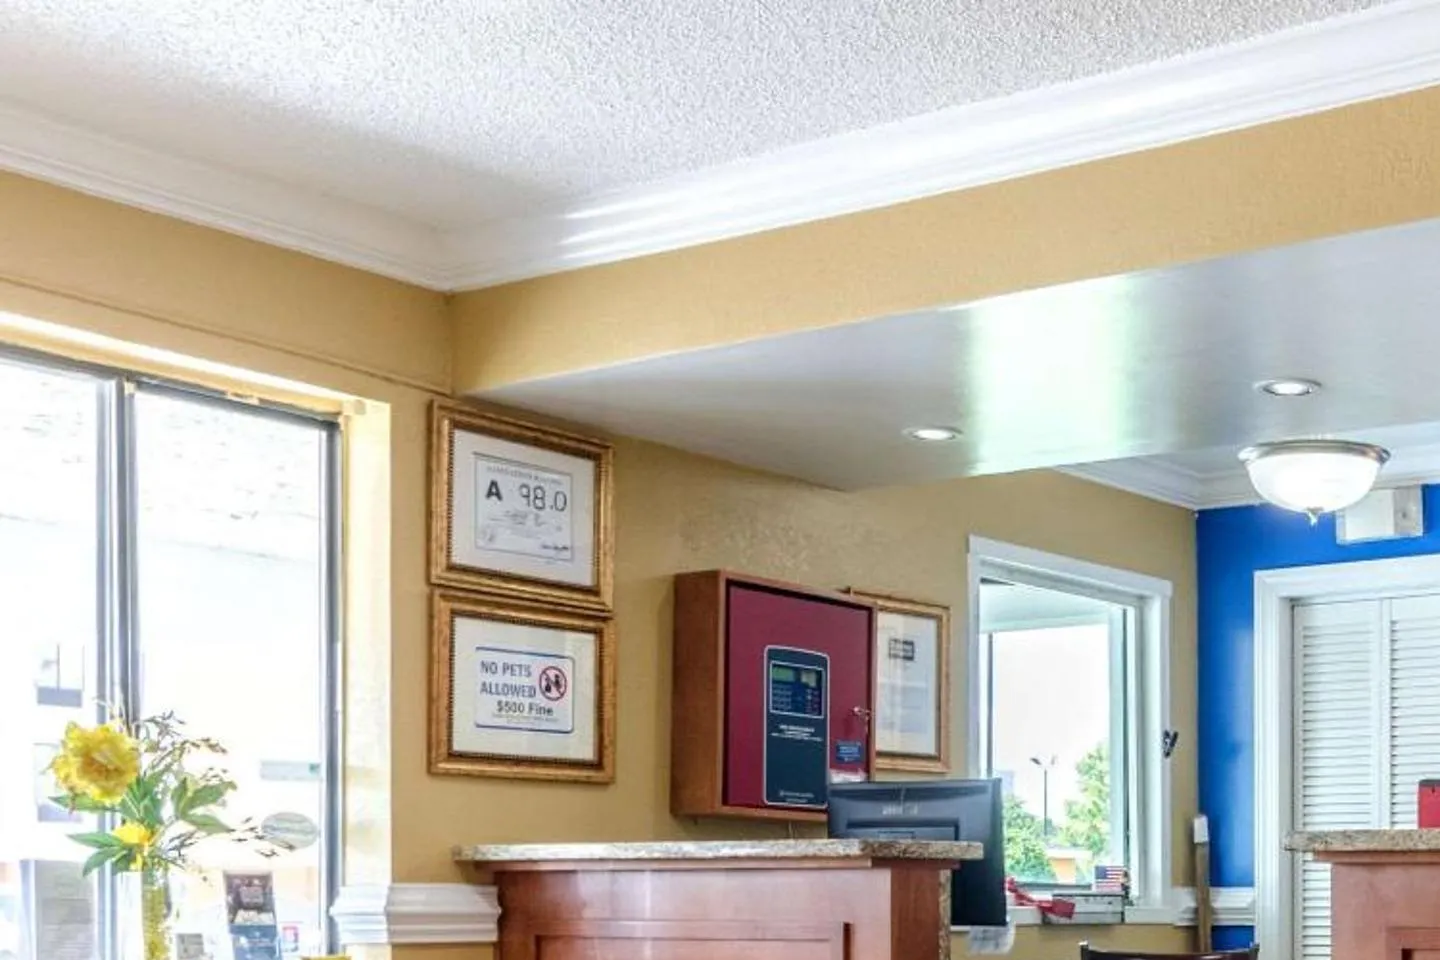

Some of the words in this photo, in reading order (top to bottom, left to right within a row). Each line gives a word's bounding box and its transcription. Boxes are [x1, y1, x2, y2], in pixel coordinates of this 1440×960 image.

[485, 479, 503, 502] A
[519, 482, 568, 512] 98.0
[481, 661, 499, 675] NO
[502, 662, 533, 678] PETS
[481, 680, 537, 698] ALLOWED
[528, 702, 554, 717] Fine
